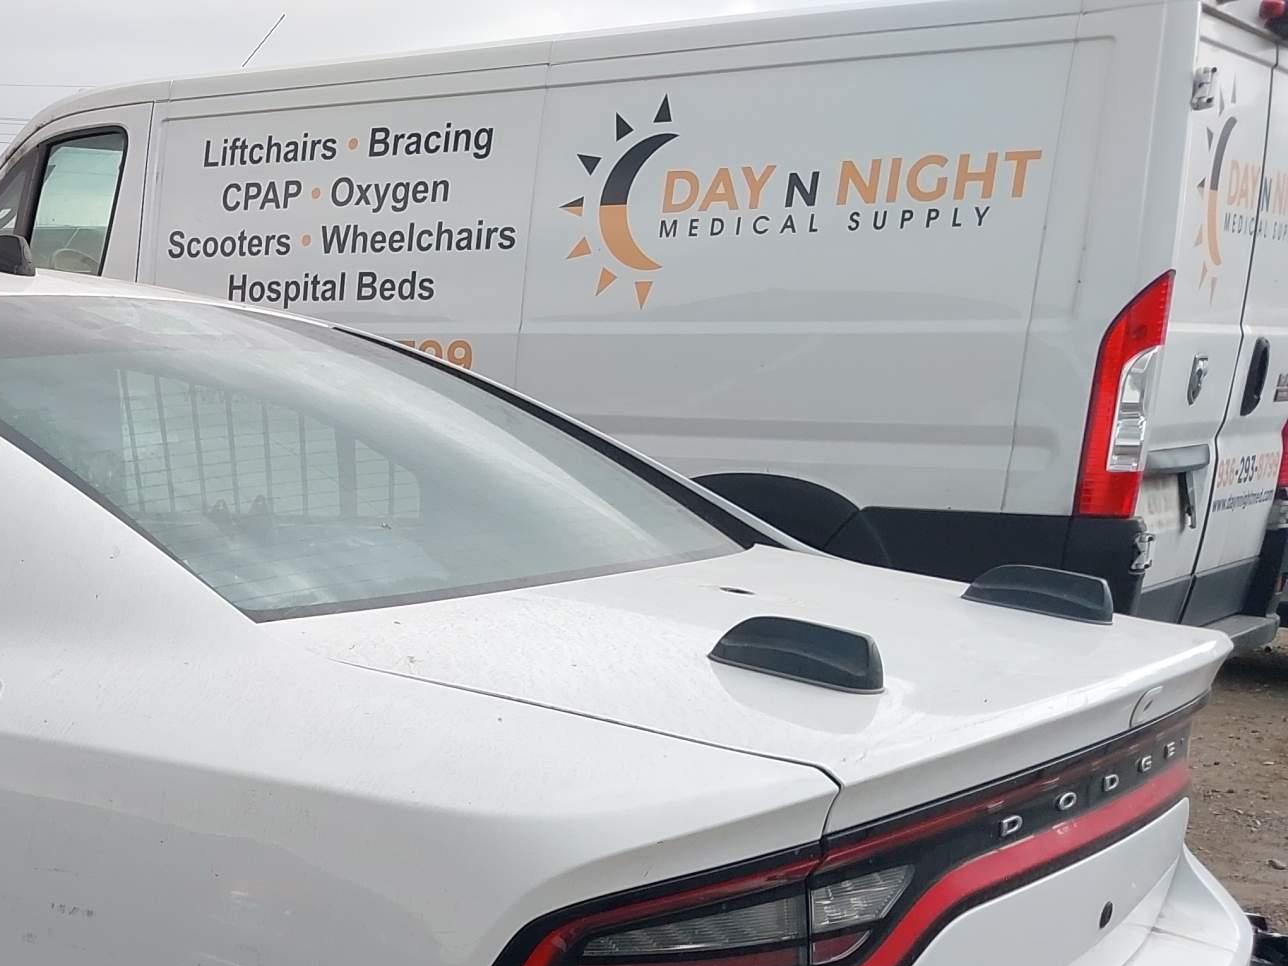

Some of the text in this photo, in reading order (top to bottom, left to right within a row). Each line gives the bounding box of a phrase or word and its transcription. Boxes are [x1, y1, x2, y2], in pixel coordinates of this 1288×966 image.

[203, 122, 494, 167] Liftchairs Bracing
[222, 176, 450, 213] CPAP Oxygen
[661, 149, 1043, 213] DAY N NIGHT
[1226, 159, 1261, 209] DAY
[1260, 175, 1273, 213] N
[168, 220, 516, 259] Scooters Wheelchairs
[659, 205, 991, 239] MEDICAL SUPPLY
[1223, 211, 1269, 239] MEDICAL
[227, 270, 435, 310] Hospital Beds
[999, 741, 1177, 838] DODGE
